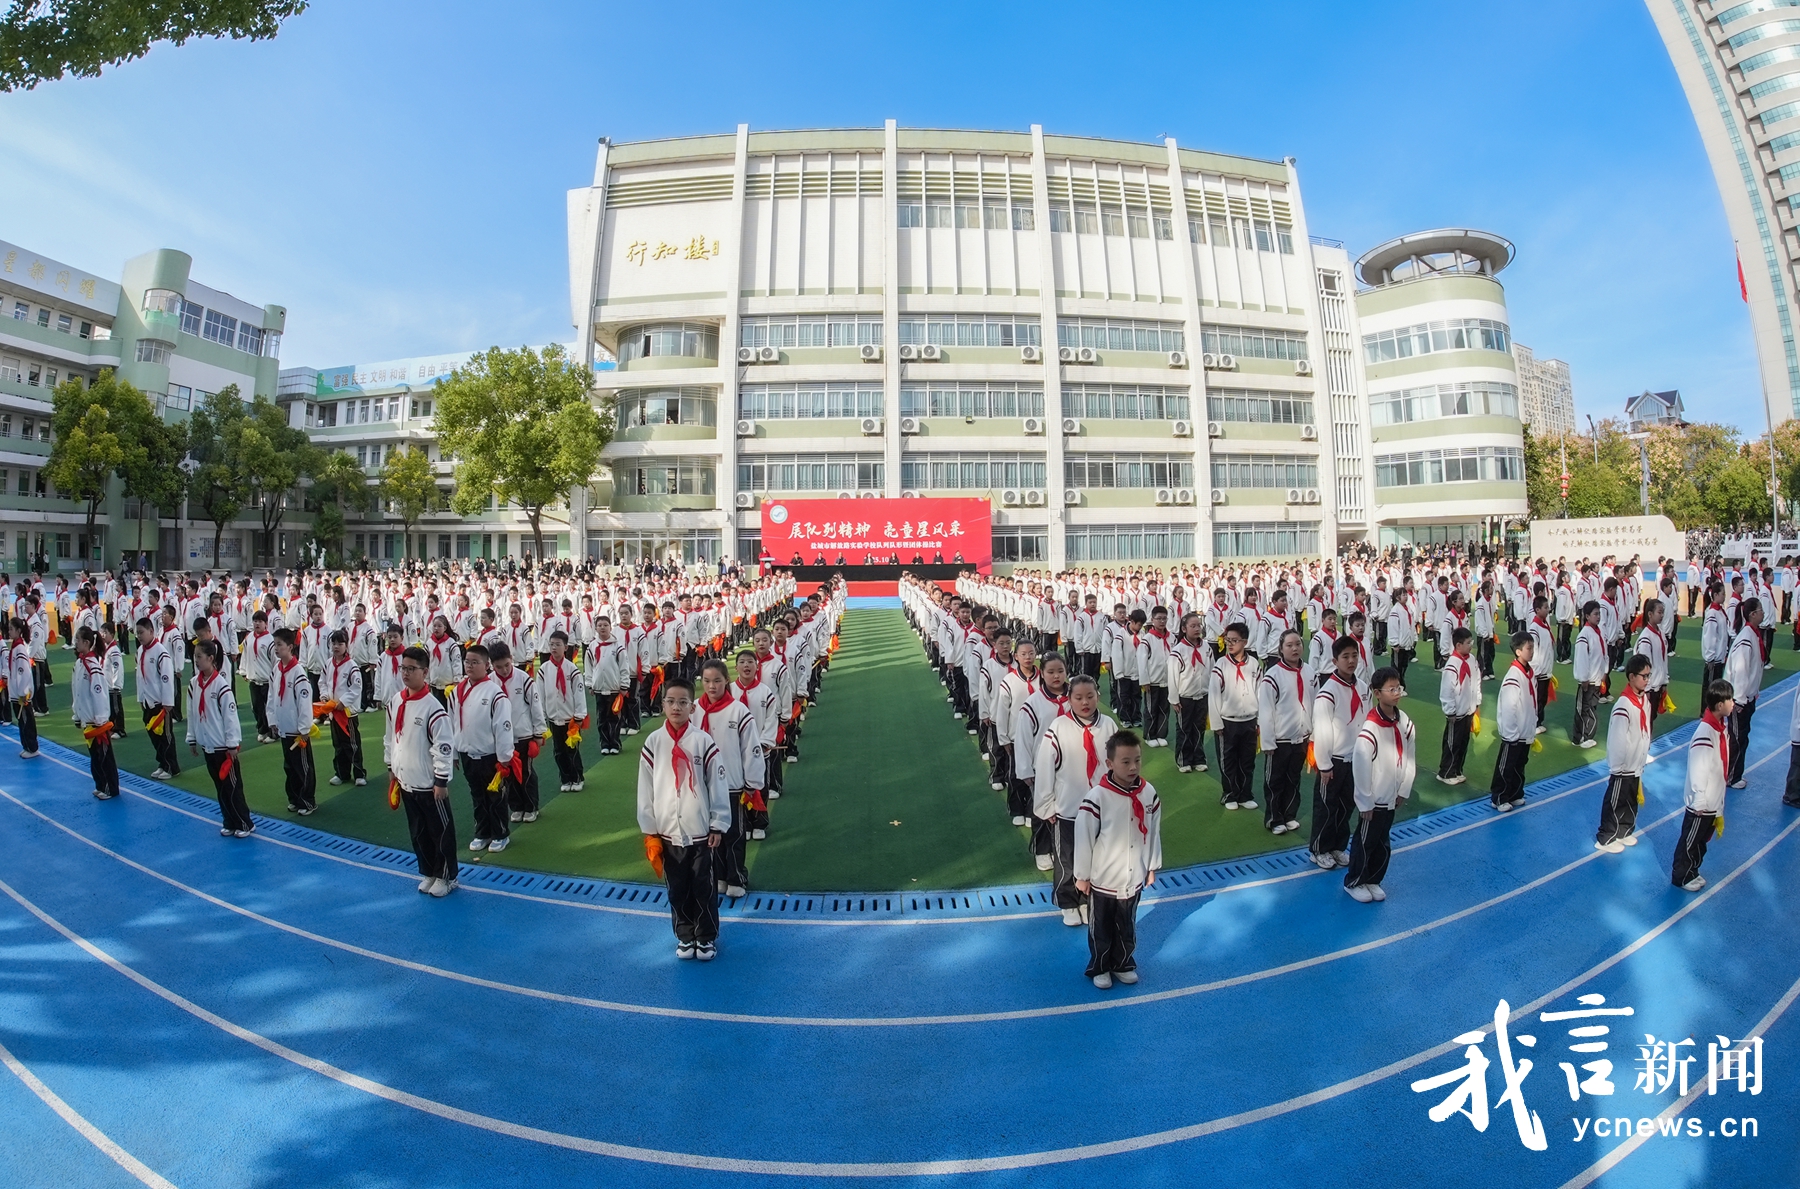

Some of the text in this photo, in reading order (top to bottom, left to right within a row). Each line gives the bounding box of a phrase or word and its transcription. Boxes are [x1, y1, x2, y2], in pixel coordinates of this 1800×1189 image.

[626, 234, 711, 267] 行知楼
[333, 373, 349, 388] 富强
[351, 371, 367, 386] 民主
[369, 369, 387, 384] 文明
[389, 367, 407, 381] 和谐
[418, 363, 436, 378] 自由
[787, 520, 965, 540] 展队列精神 亮童星风采
